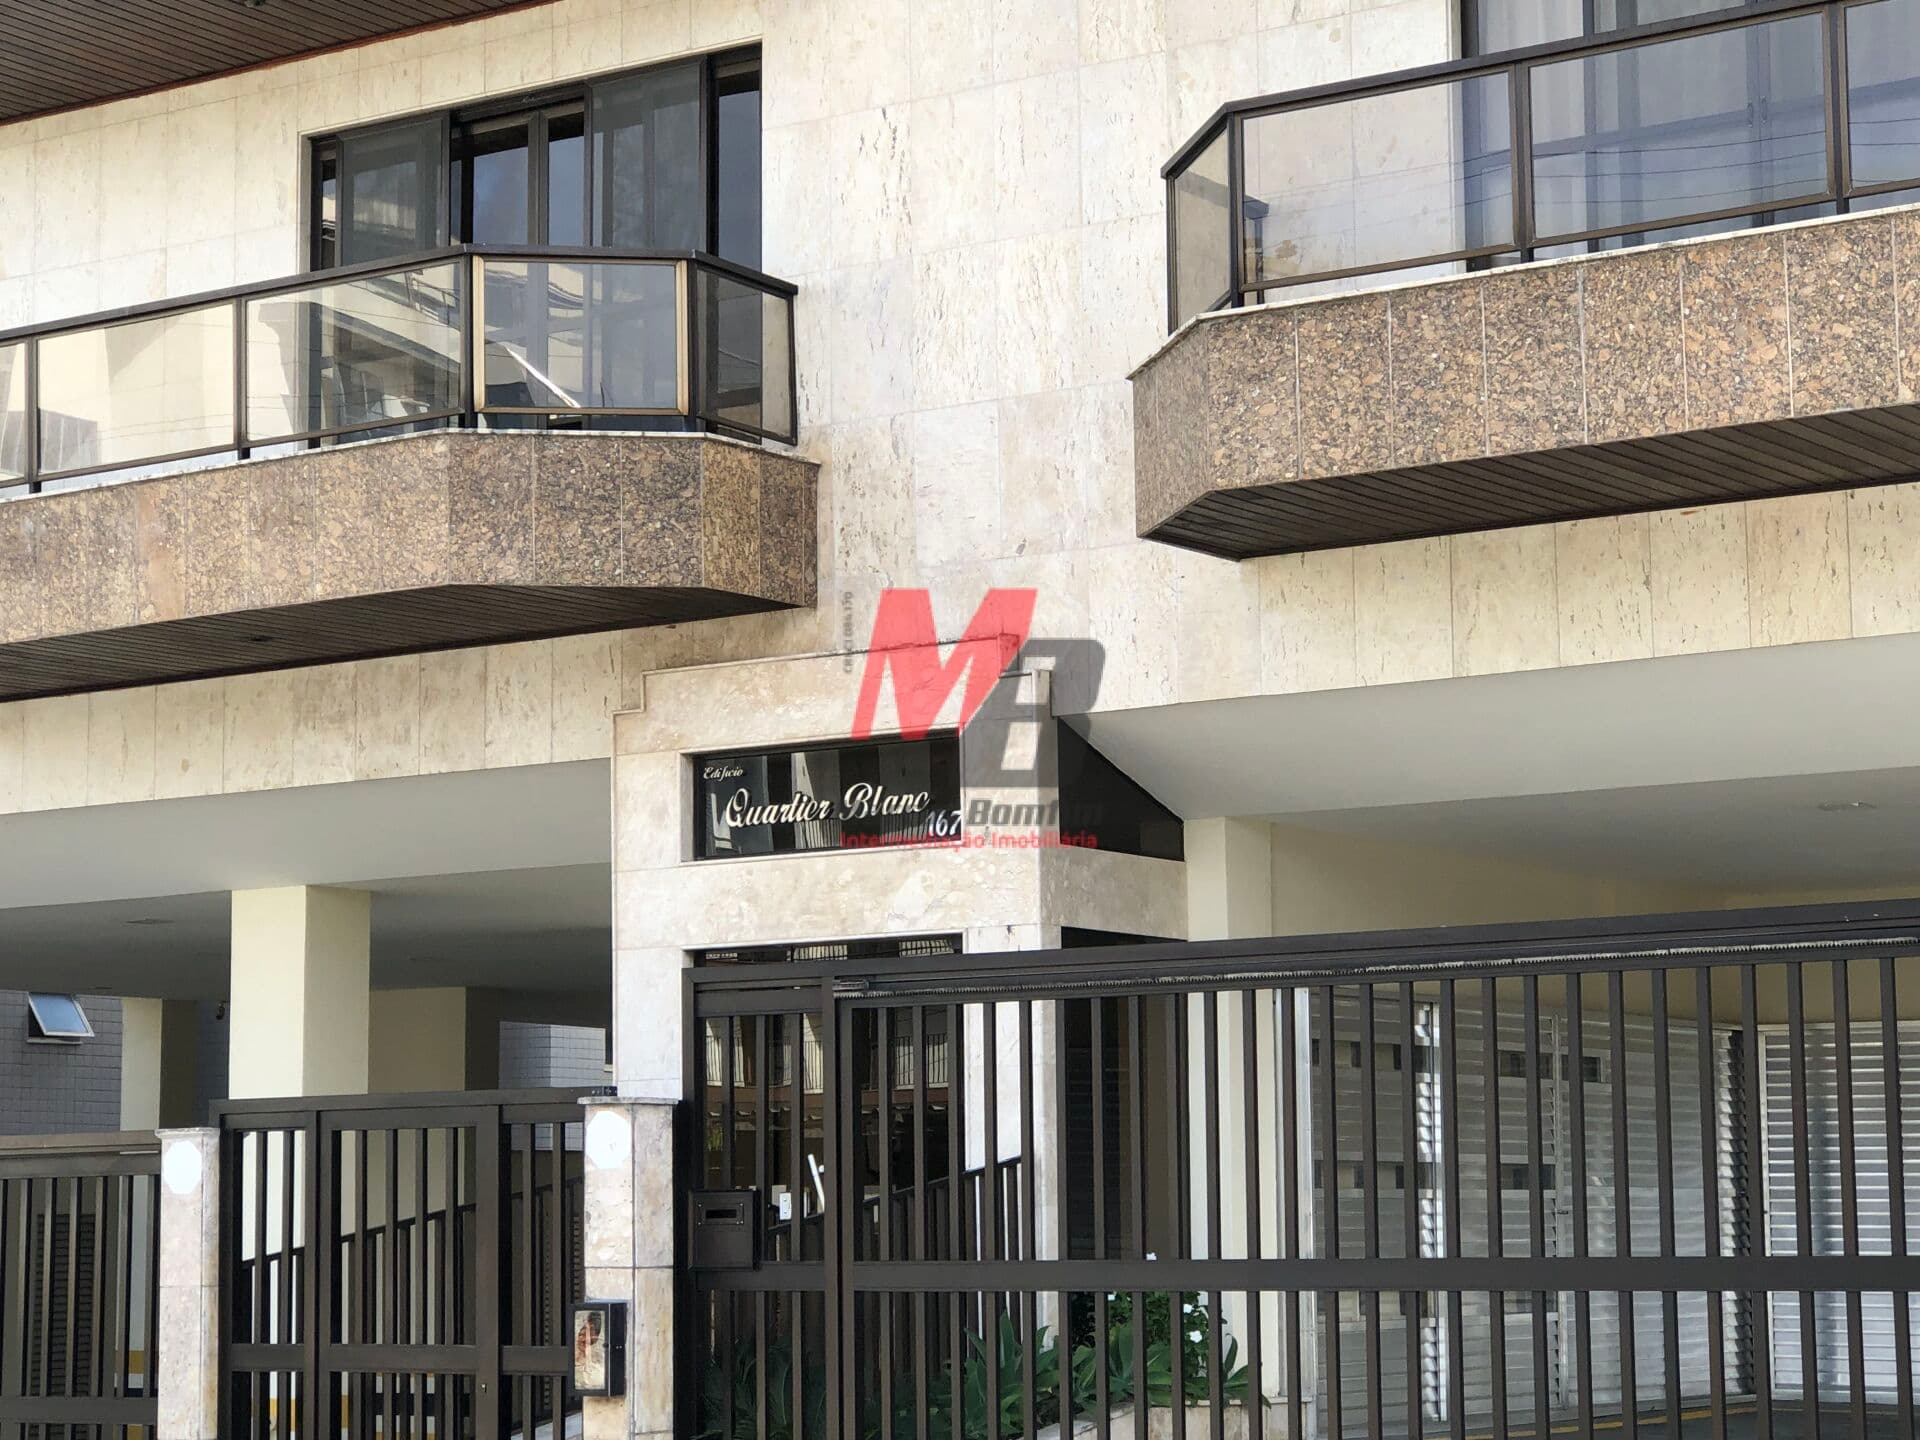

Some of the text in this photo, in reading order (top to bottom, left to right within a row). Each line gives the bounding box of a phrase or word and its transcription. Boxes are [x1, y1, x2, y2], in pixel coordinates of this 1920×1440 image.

[726, 783, 930, 828] Quartier Blanc
[927, 809, 964, 838] 167
